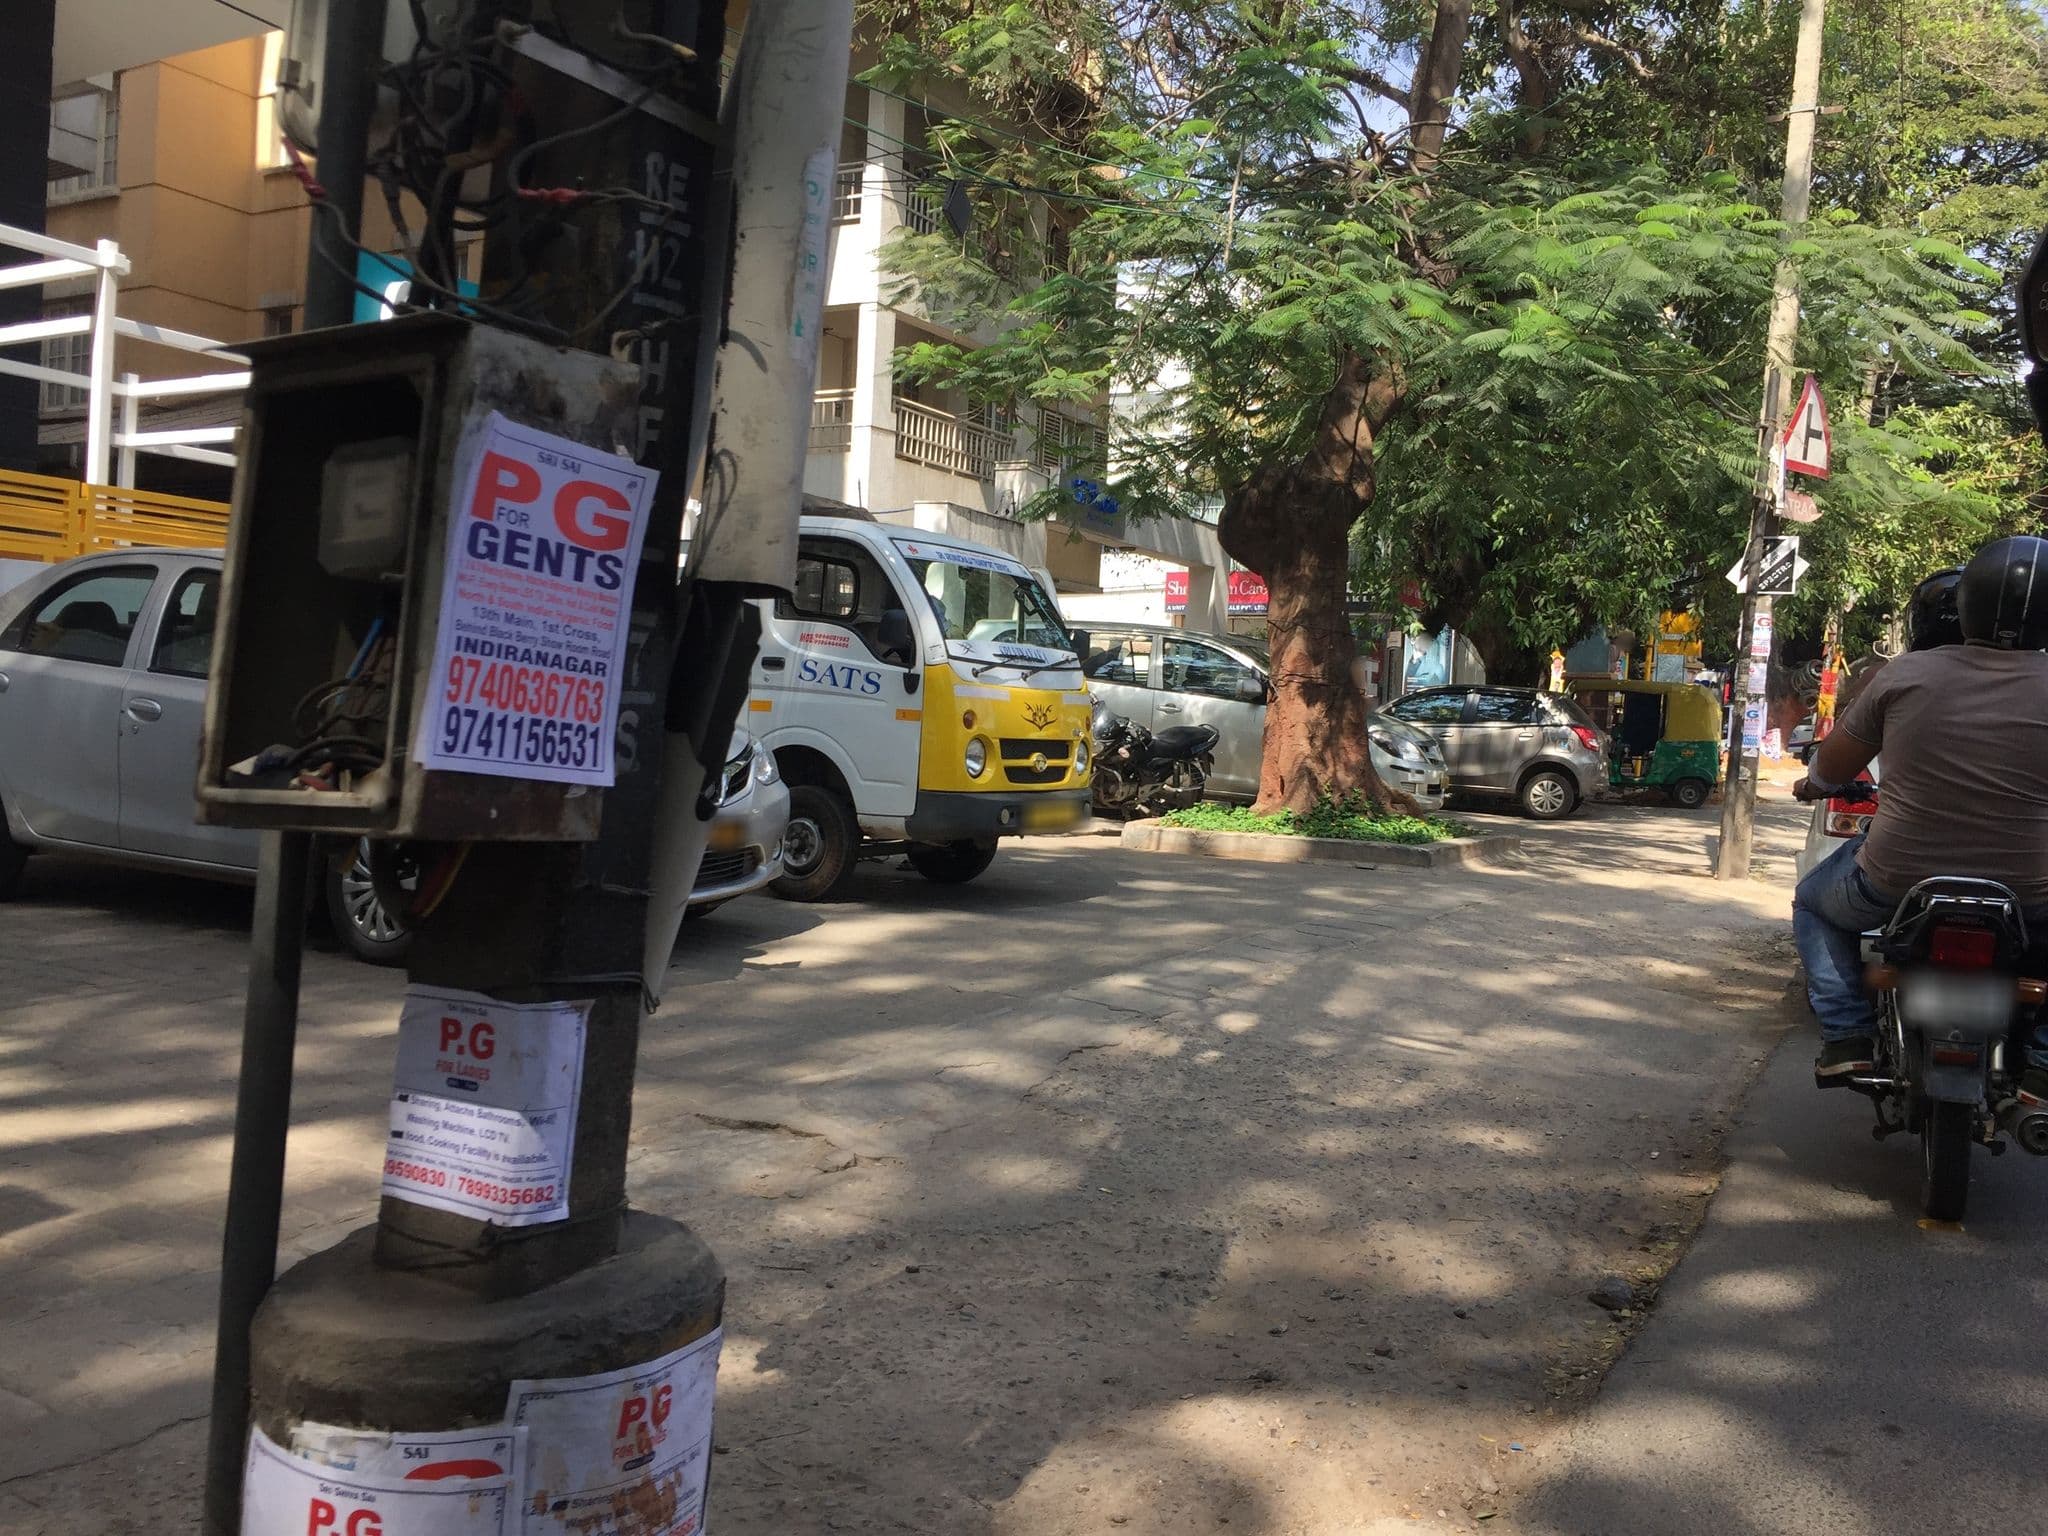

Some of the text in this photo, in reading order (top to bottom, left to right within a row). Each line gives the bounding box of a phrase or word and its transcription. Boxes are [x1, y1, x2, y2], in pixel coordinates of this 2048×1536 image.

[560, 459, 581, 475] SAI
[496, 506, 530, 528] FOR
[467, 521, 624, 591] GENTS
[471, 605, 500, 621] 13th
[542, 620, 560, 635] 1st
[455, 635, 608, 678] INDIRANAGAR
[446, 655, 604, 725] 9740636763
[798, 658, 882, 695] SATS
[442, 705, 601, 769] 9741156531
[457, 1175, 556, 1205] 7899335682
